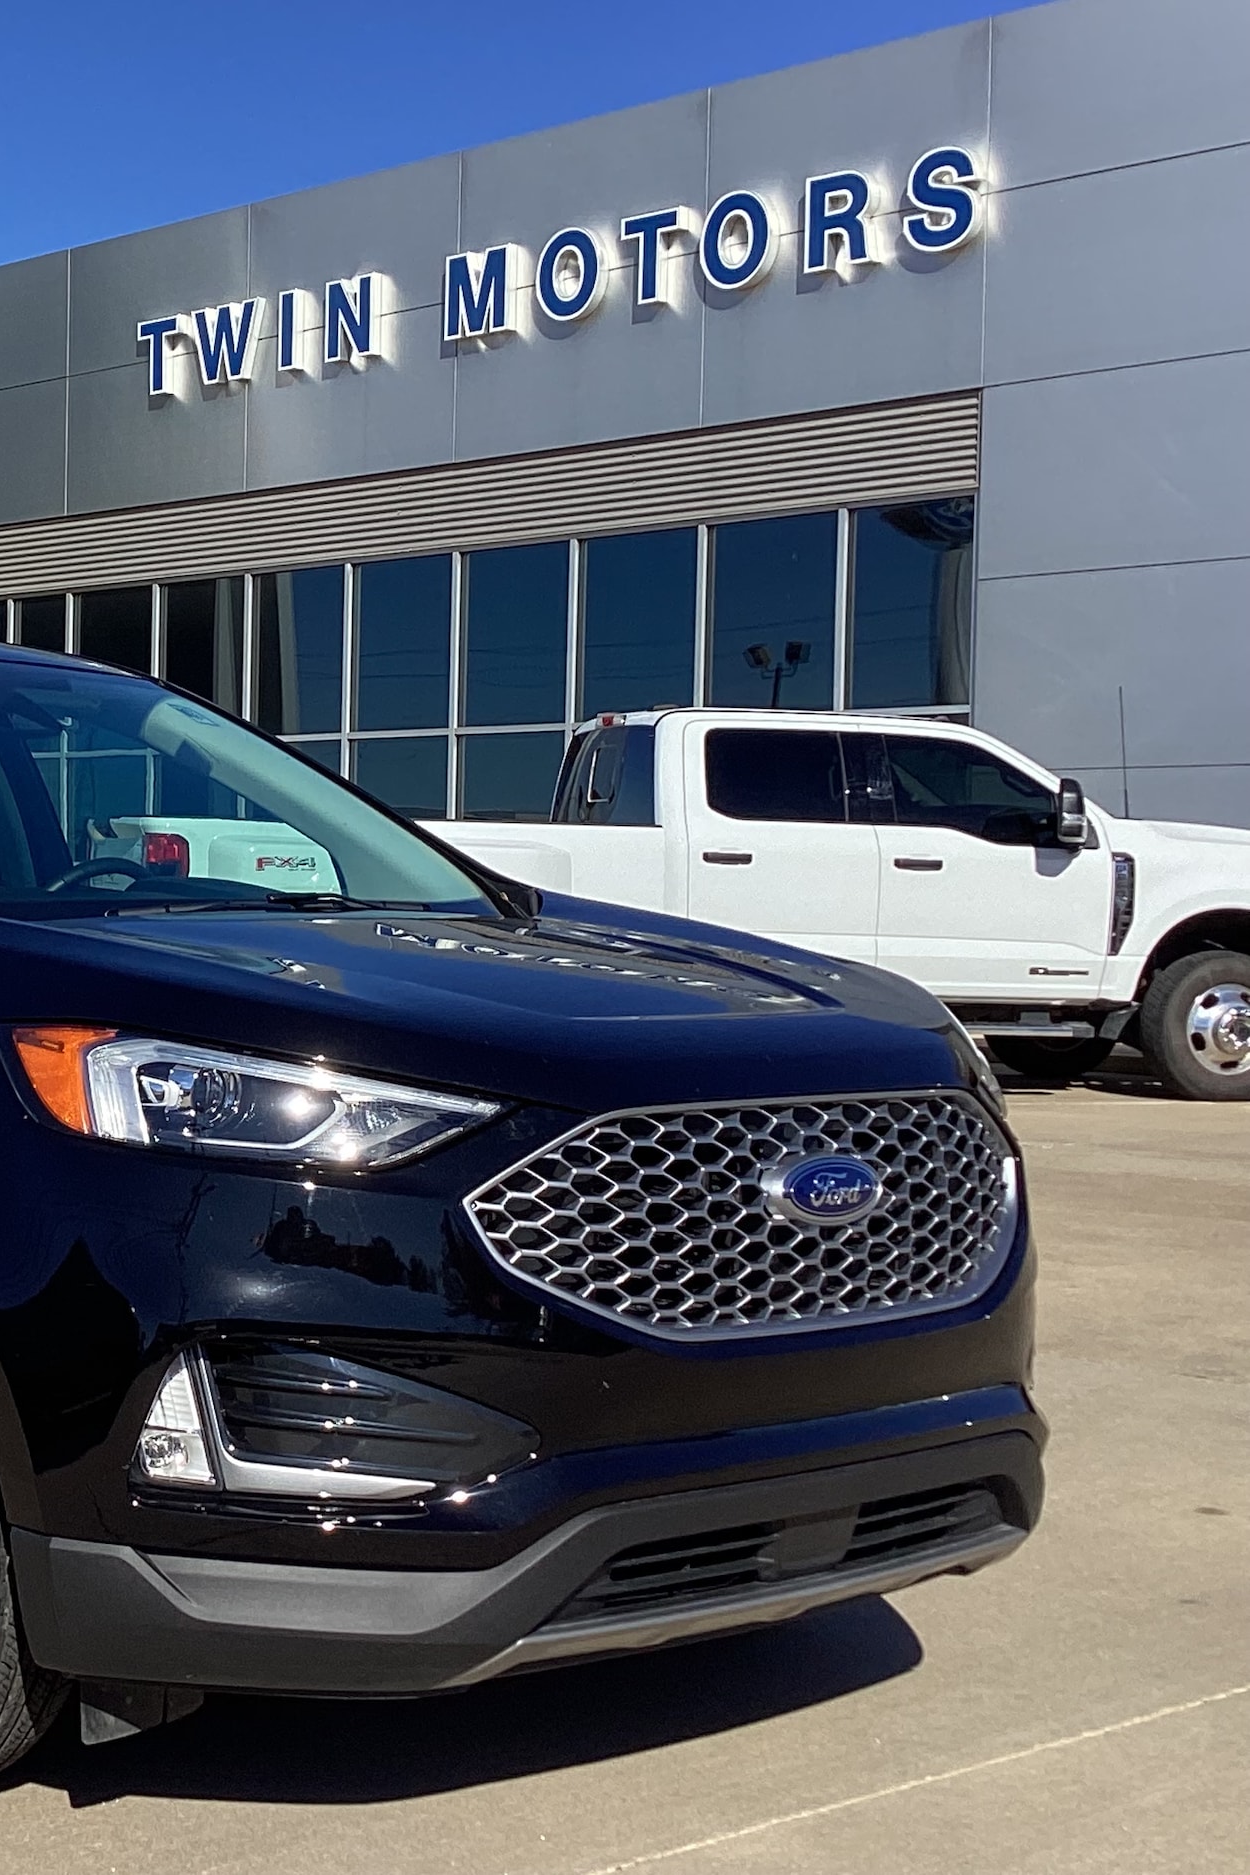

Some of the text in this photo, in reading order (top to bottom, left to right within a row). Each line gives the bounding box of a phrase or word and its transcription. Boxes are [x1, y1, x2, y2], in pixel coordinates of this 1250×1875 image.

[137, 146, 988, 396] TWIN MOTORS
[256, 856, 317, 871] FX4
[810, 1171, 863, 1207] Ford
